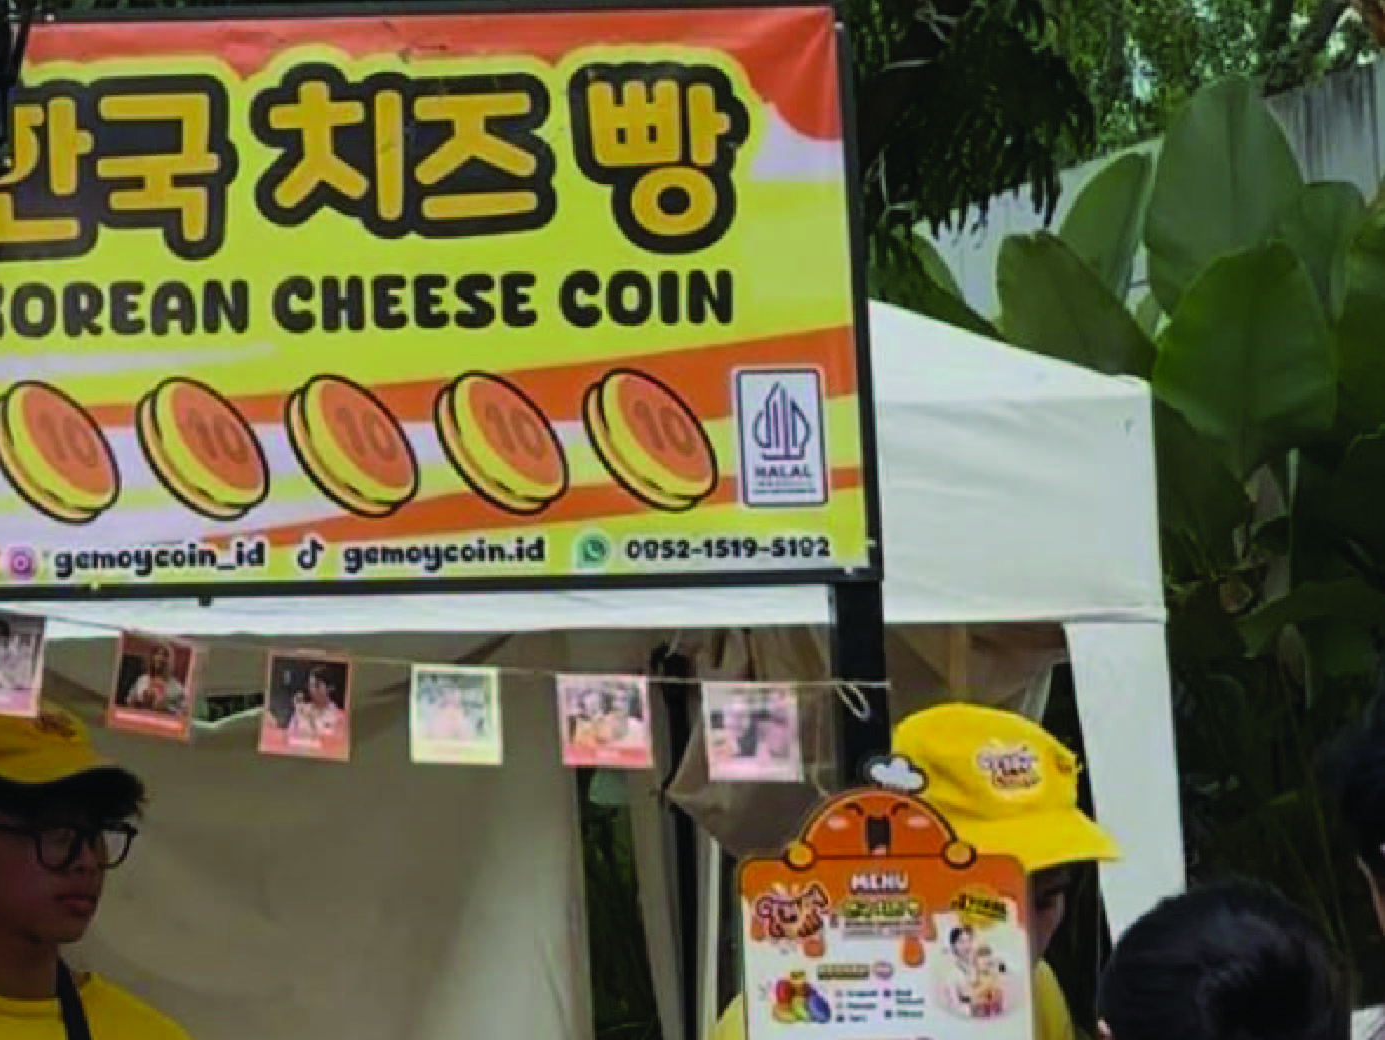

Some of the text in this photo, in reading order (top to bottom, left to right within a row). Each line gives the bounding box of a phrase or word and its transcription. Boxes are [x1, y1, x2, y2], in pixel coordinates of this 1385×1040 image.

[264, 74, 543, 228] 치즈
[584, 76, 733, 243] 빵
[272, 272, 538, 333] CHEESE
[559, 270, 734, 328] COIN
[54, 541, 265, 577] gemoycoin_id
[343, 536, 545, 574] gemoycoin.id
